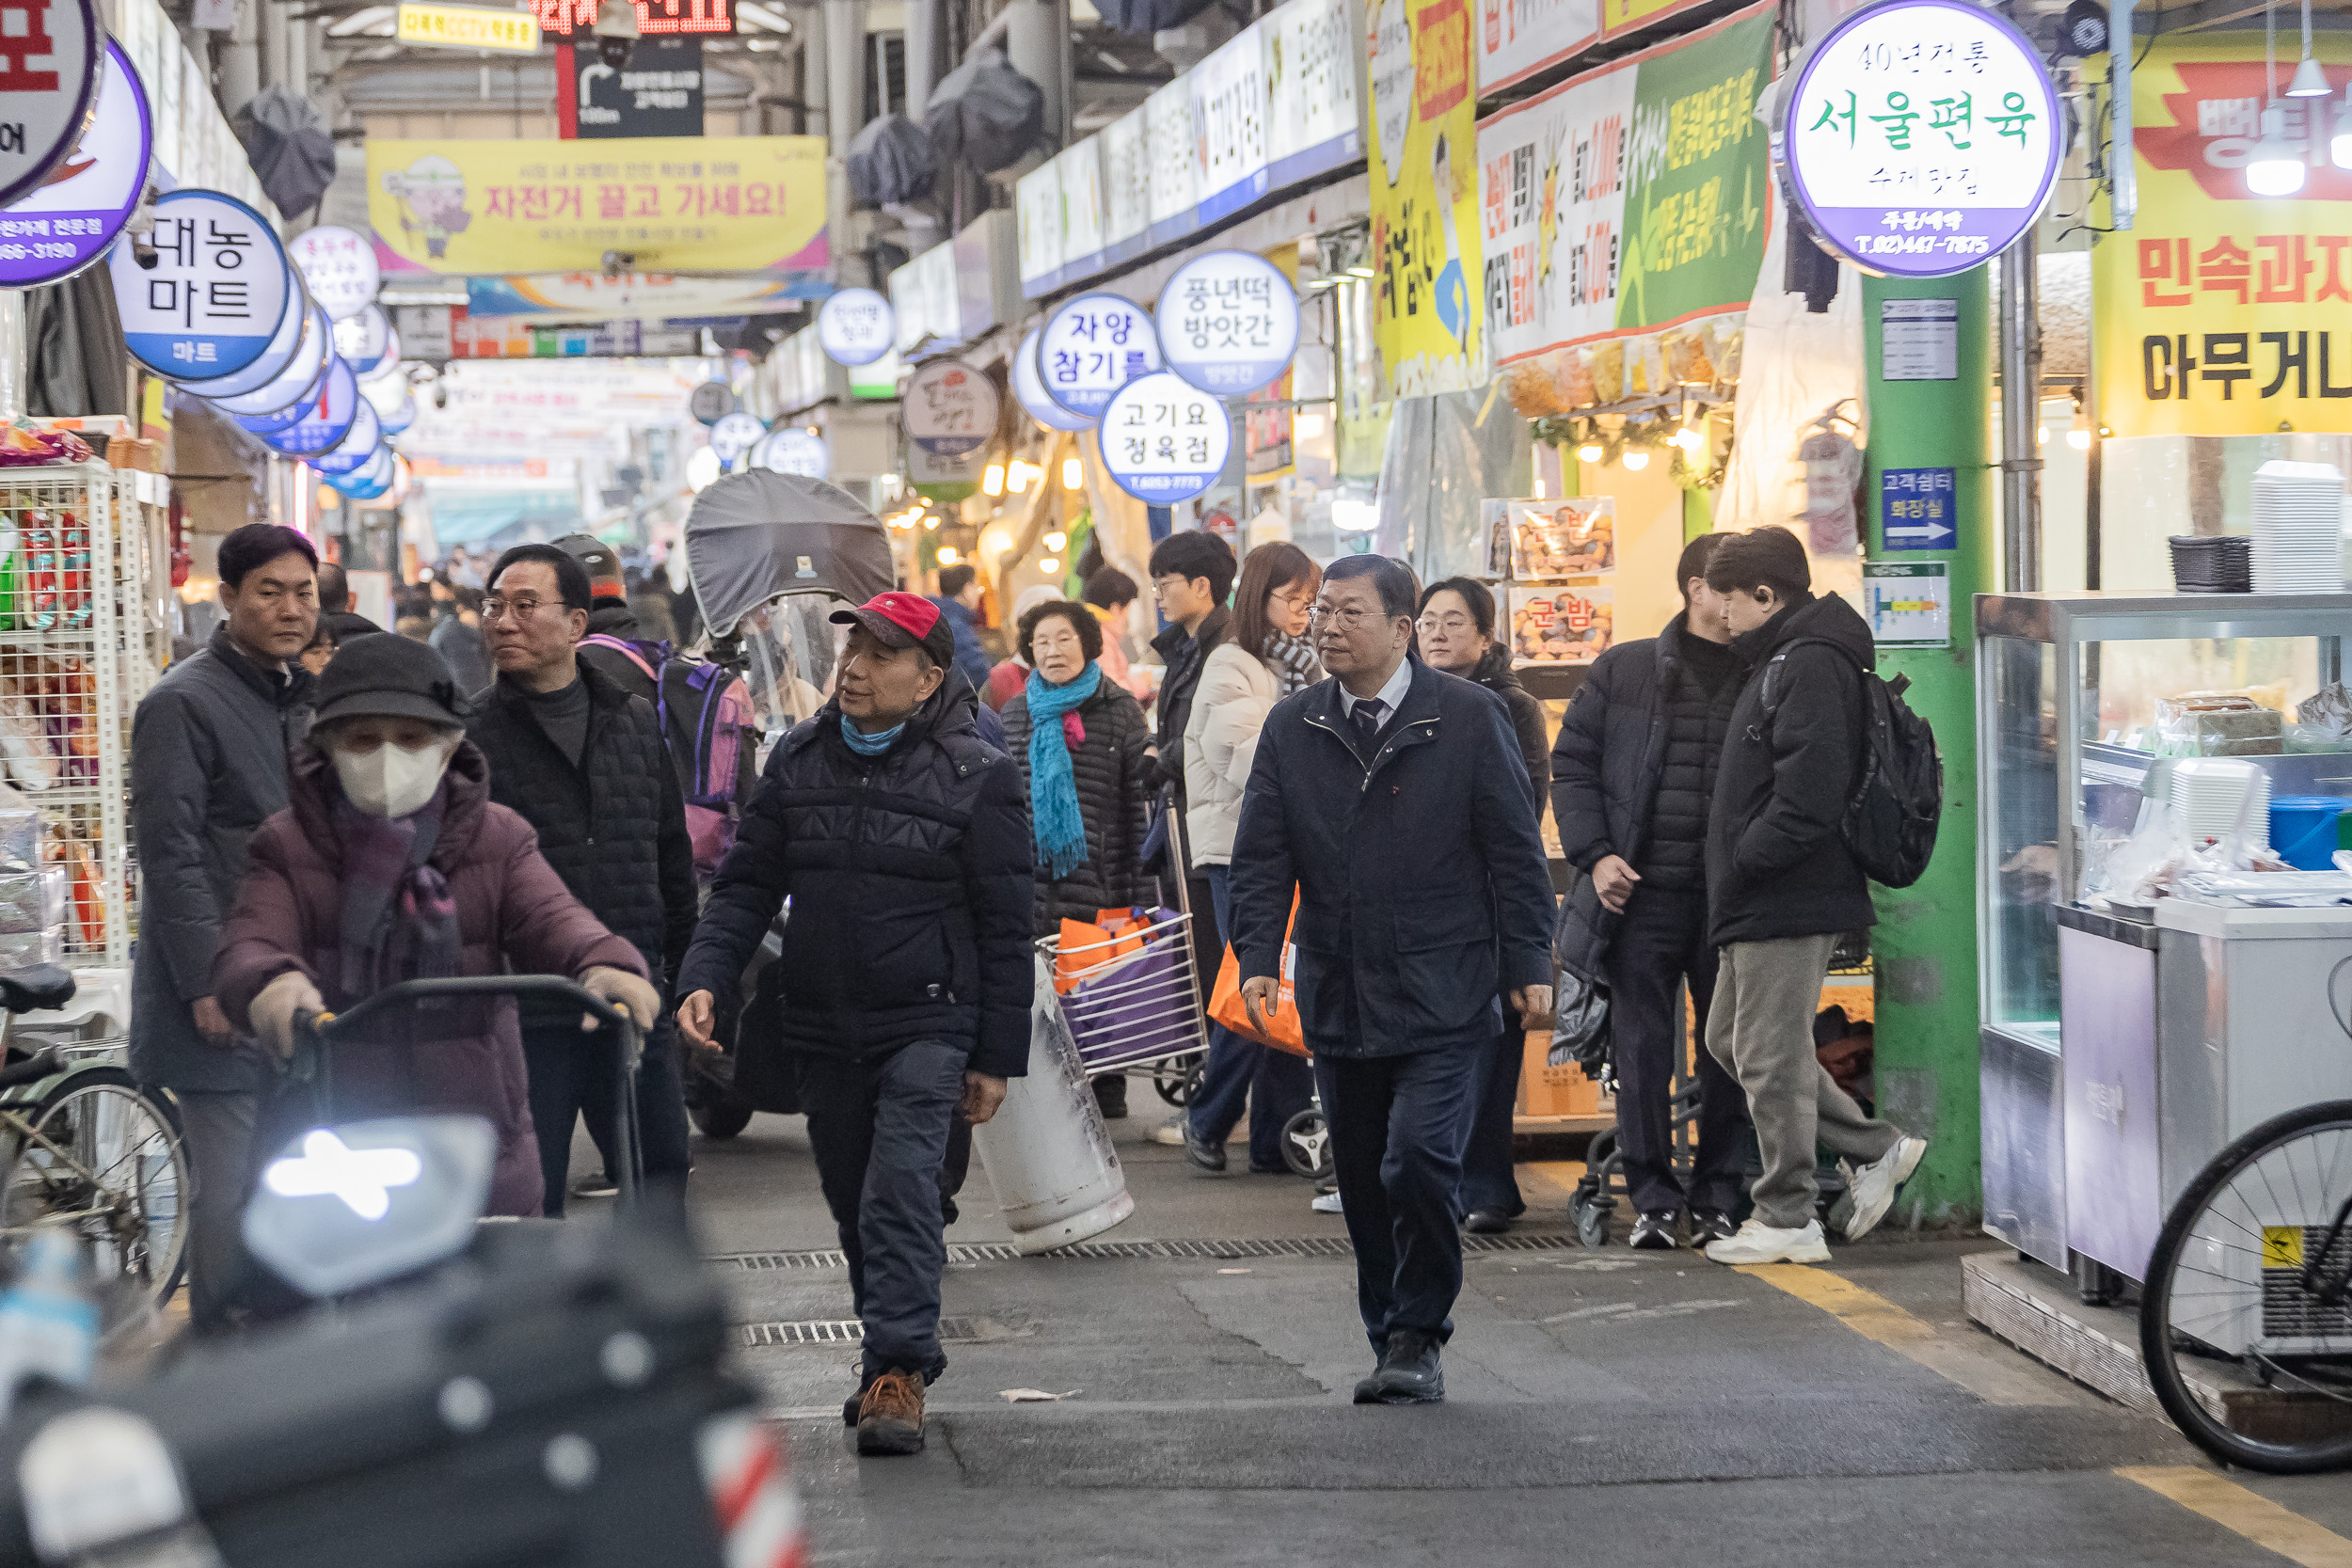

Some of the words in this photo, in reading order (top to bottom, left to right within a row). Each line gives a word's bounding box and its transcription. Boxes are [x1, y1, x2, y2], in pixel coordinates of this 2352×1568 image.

[1809, 89, 2036, 150] 서울편육
[484, 184, 582, 220] 자전거
[596, 183, 662, 220] 끌고
[675, 182, 787, 218] 가세요!
[151, 218, 252, 268] 대농
[150, 279, 251, 328] 마트
[1184, 277, 1272, 312] 풍년떡
[1069, 312, 1133, 345] 자양
[1184, 315, 1274, 349] 방앗간
[172, 341, 218, 363] 마트
[1122, 403, 1208, 427] 고기요
[1124, 435, 1209, 465] 정육점
[1883, 473, 1952, 492] 고객쉼터
[1890, 499, 1943, 518] 화장실
[1531, 599, 1593, 628] 군밤
